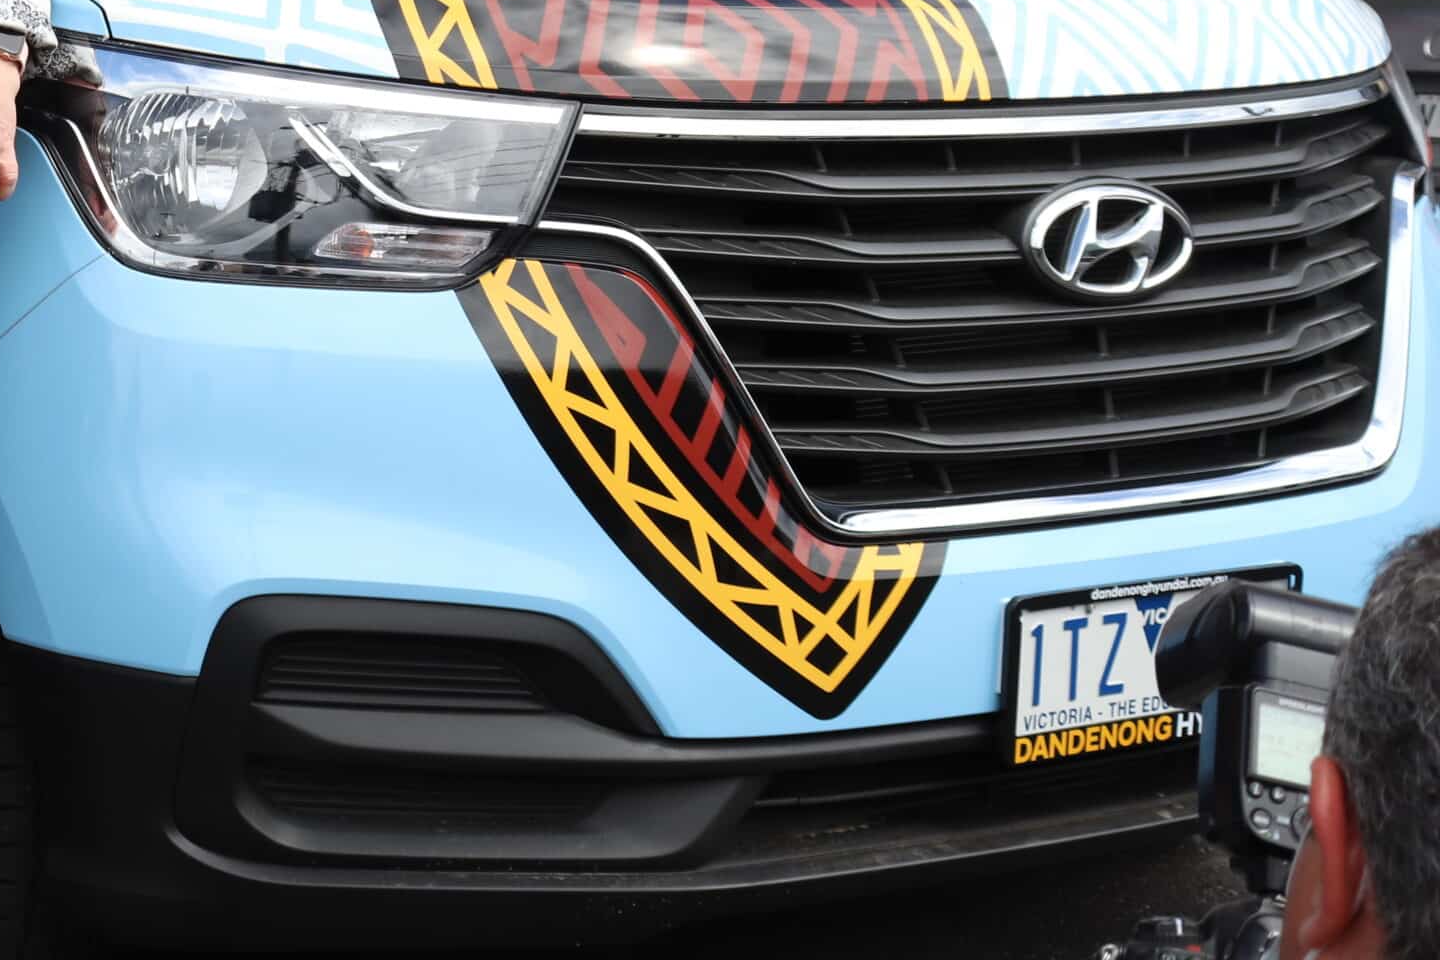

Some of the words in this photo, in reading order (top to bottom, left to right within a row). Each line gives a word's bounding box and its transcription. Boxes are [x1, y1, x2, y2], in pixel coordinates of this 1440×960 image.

[1140, 607, 1168, 626] VIC
[1024, 706, 1092, 731] VICTORIA
[1109, 699, 1136, 718] THE
[1014, 715, 1173, 764] DANDENONG
